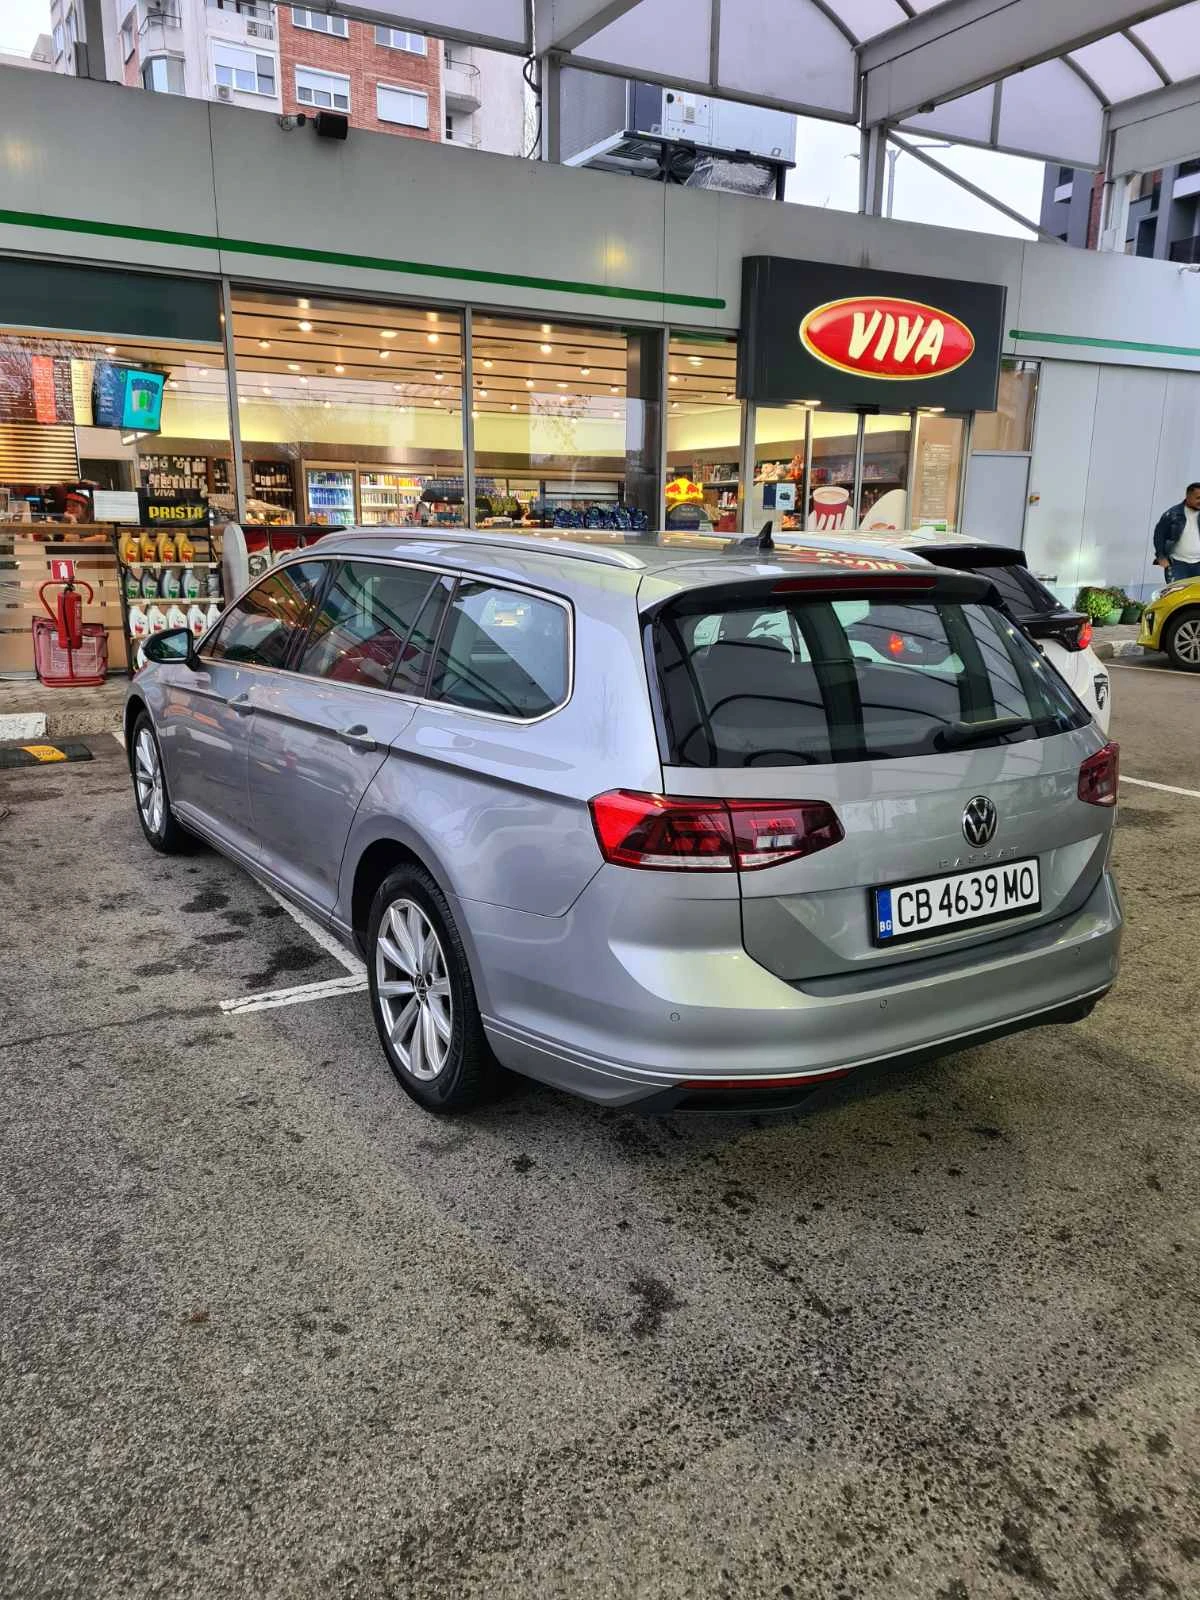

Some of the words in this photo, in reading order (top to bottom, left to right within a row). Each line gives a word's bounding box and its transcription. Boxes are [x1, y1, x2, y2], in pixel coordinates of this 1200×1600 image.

[848, 309, 945, 366] VIVA
[154, 489, 176, 497] VIVA
[148, 506, 205, 519] PRISTA
[897, 888, 933, 928] CB
[938, 874, 998, 918] 4639
[1003, 867, 1034, 905] MO
[879, 920, 892, 932] BG
